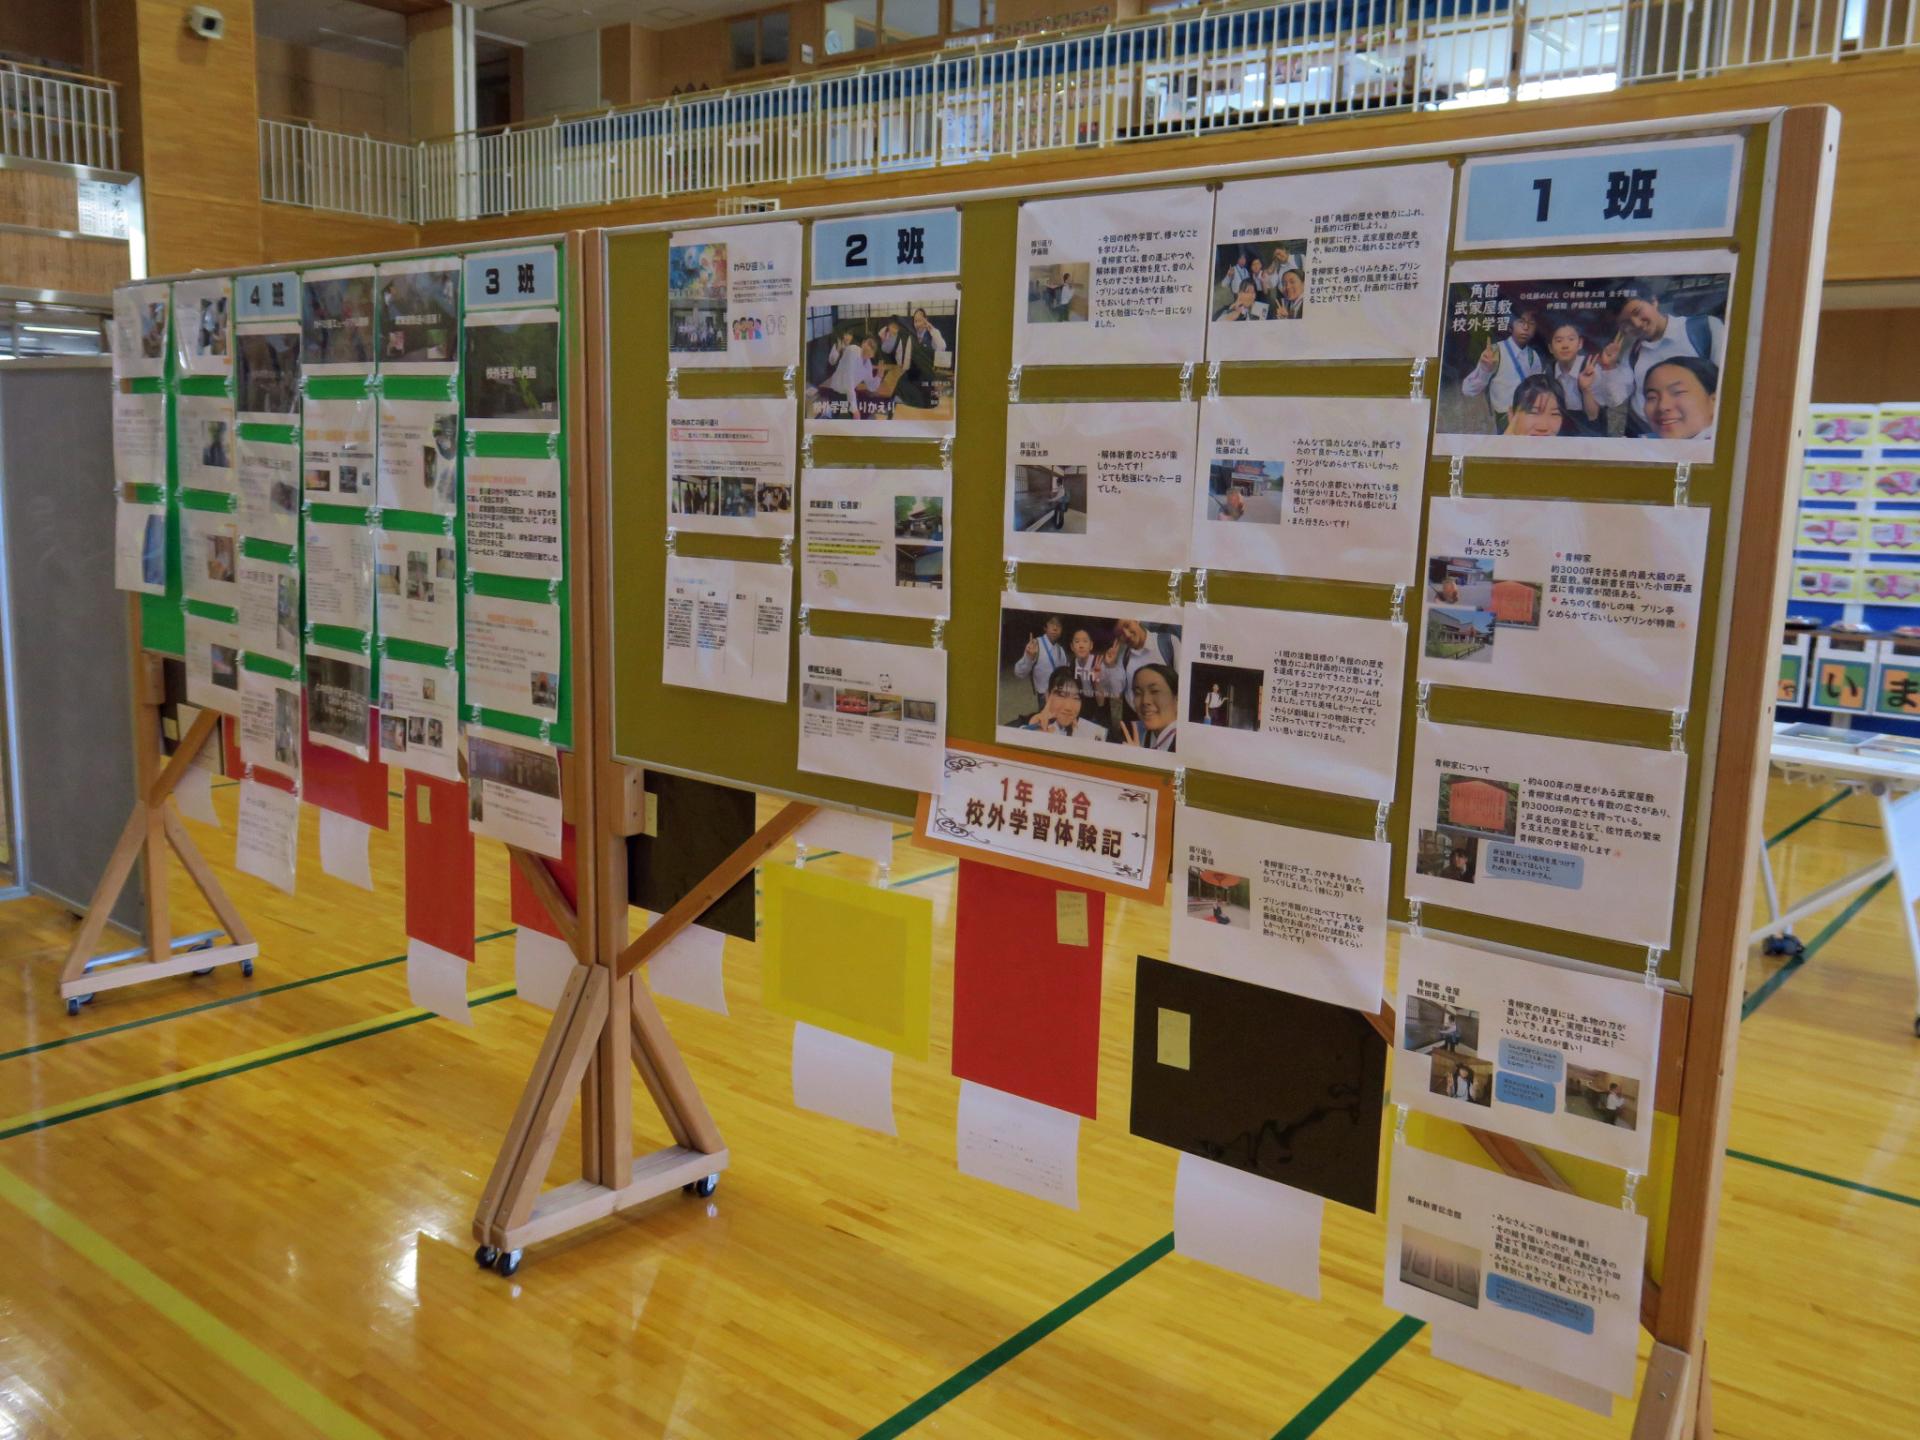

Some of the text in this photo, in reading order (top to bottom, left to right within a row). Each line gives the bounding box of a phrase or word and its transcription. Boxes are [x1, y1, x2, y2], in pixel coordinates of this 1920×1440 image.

[1533, 168, 1657, 222] 1 班
[846, 227, 924, 267] 2 班
[485, 263, 535, 295] 3 班
[250, 285, 260, 307] 4
[1471, 283, 1499, 299] 角館
[1454, 299, 1513, 316] 武家屋敷
[1452, 316, 1510, 333] 校外学習
[1565, 553, 1591, 562] 青柳家
[1435, 758, 1490, 773] 青柳家について
[1000, 777, 1092, 821] 1年 総合
[965, 798, 1122, 859] 校外学習体験記
